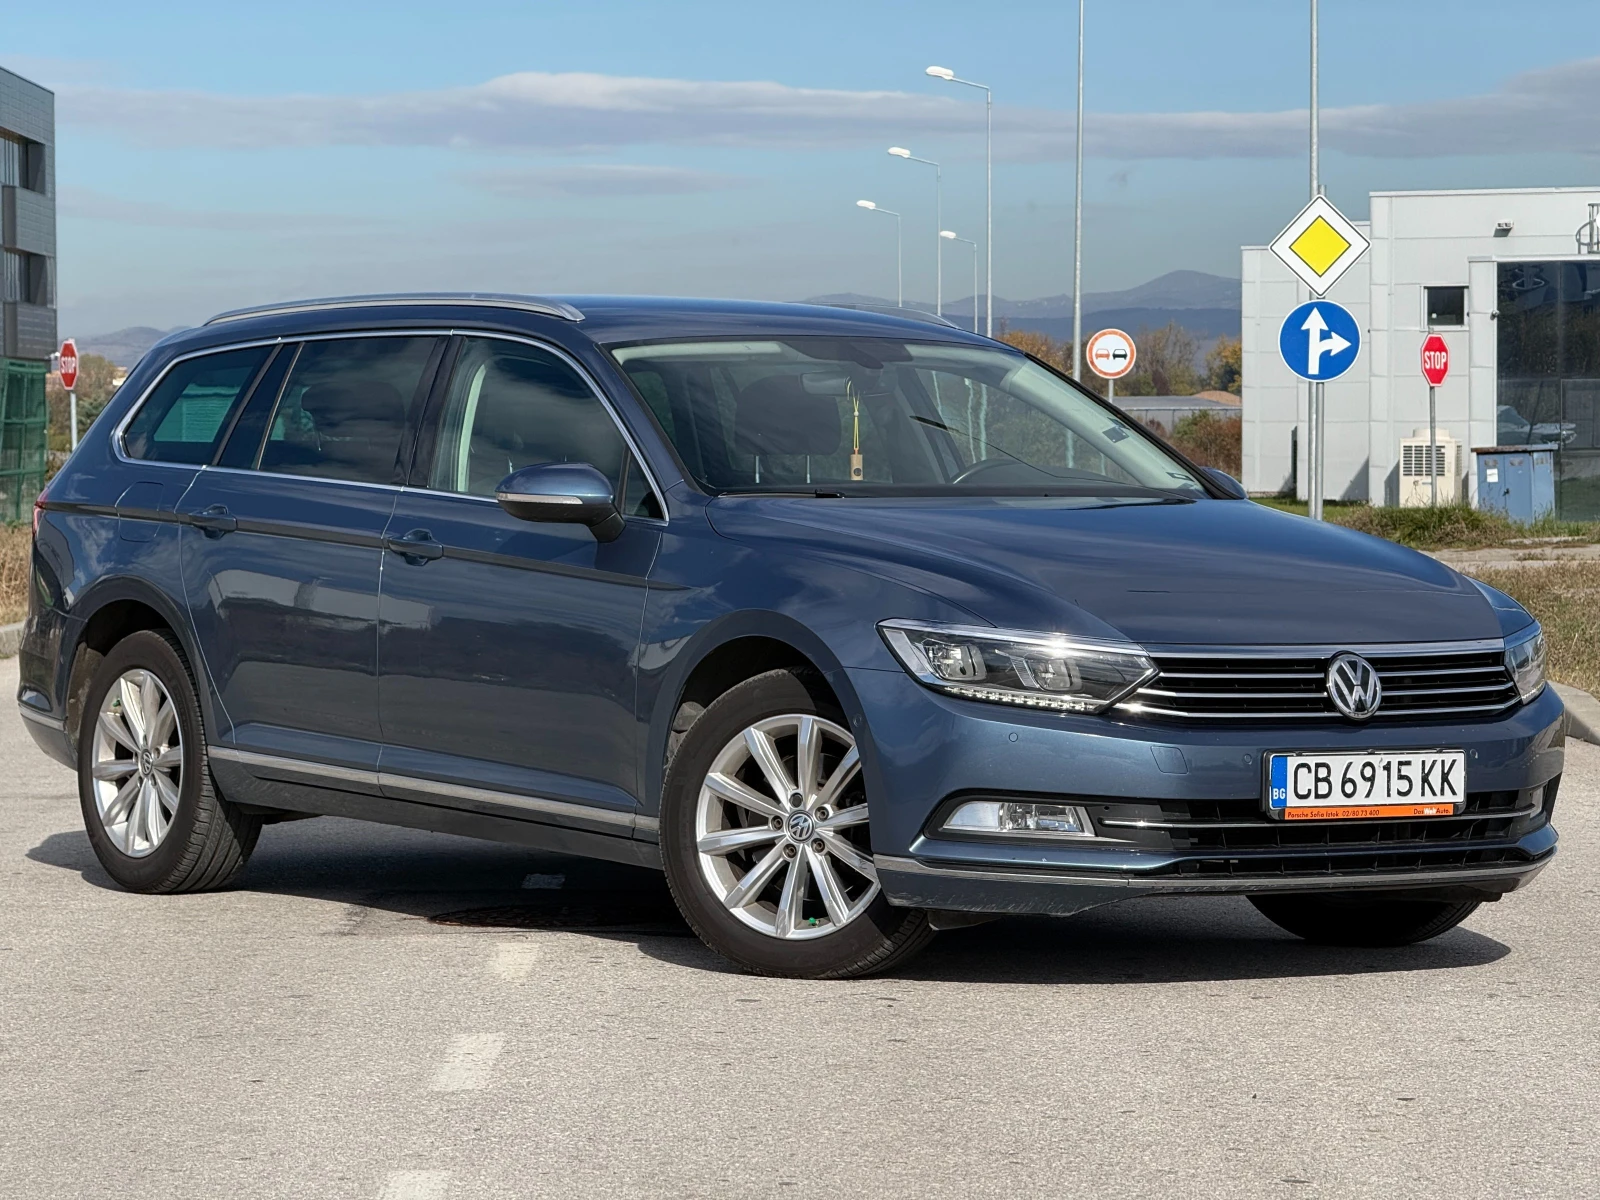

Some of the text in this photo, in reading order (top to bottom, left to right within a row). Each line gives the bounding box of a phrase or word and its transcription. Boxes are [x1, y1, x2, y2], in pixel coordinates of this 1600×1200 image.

[61, 356, 76, 374] STOP
[1424, 351, 1447, 369] STOP
[1273, 788, 1286, 800] BG
[1287, 811, 1309, 819] Porsche
[1310, 810, 1325, 818] Sofia
